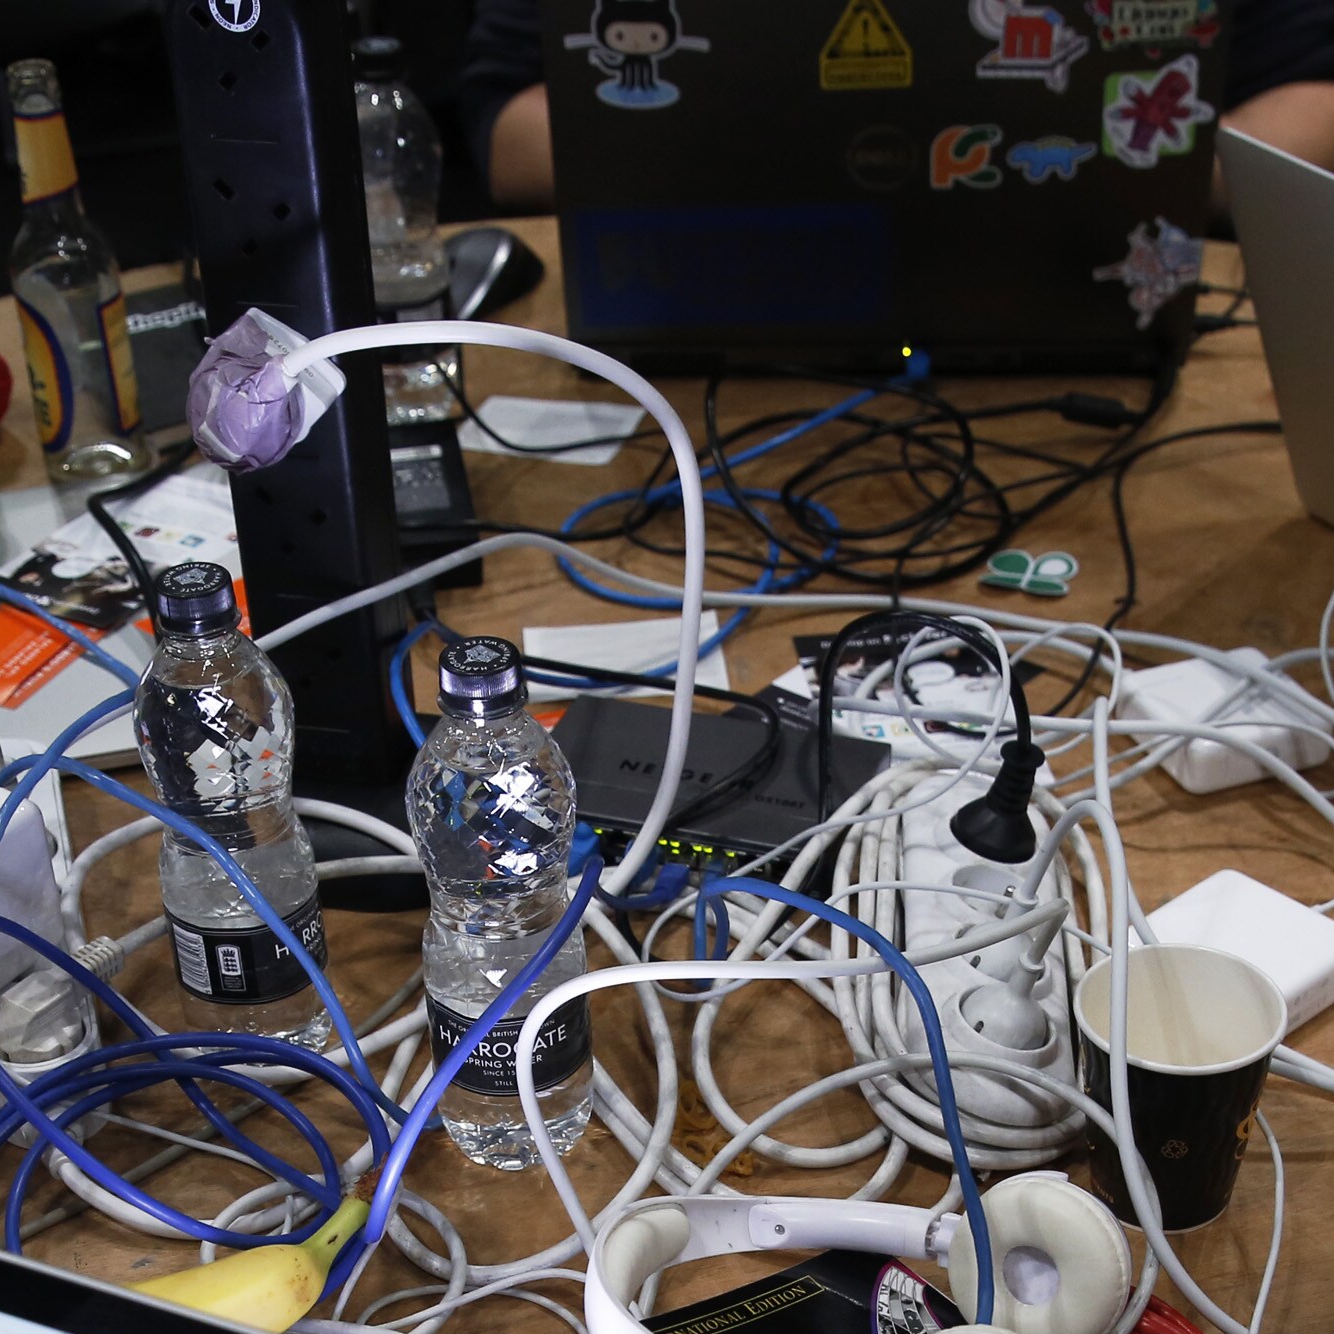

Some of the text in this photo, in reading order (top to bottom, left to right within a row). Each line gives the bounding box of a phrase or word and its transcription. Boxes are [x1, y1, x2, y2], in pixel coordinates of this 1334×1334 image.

[243, 0, 260, 29] NDICATOR
[439, 1023, 567, 1058] HAROATE
[492, 1030, 517, 1038] BRITISH
[506, 1054, 543, 1068] WER
[747, 1284, 807, 1316] EDITION
